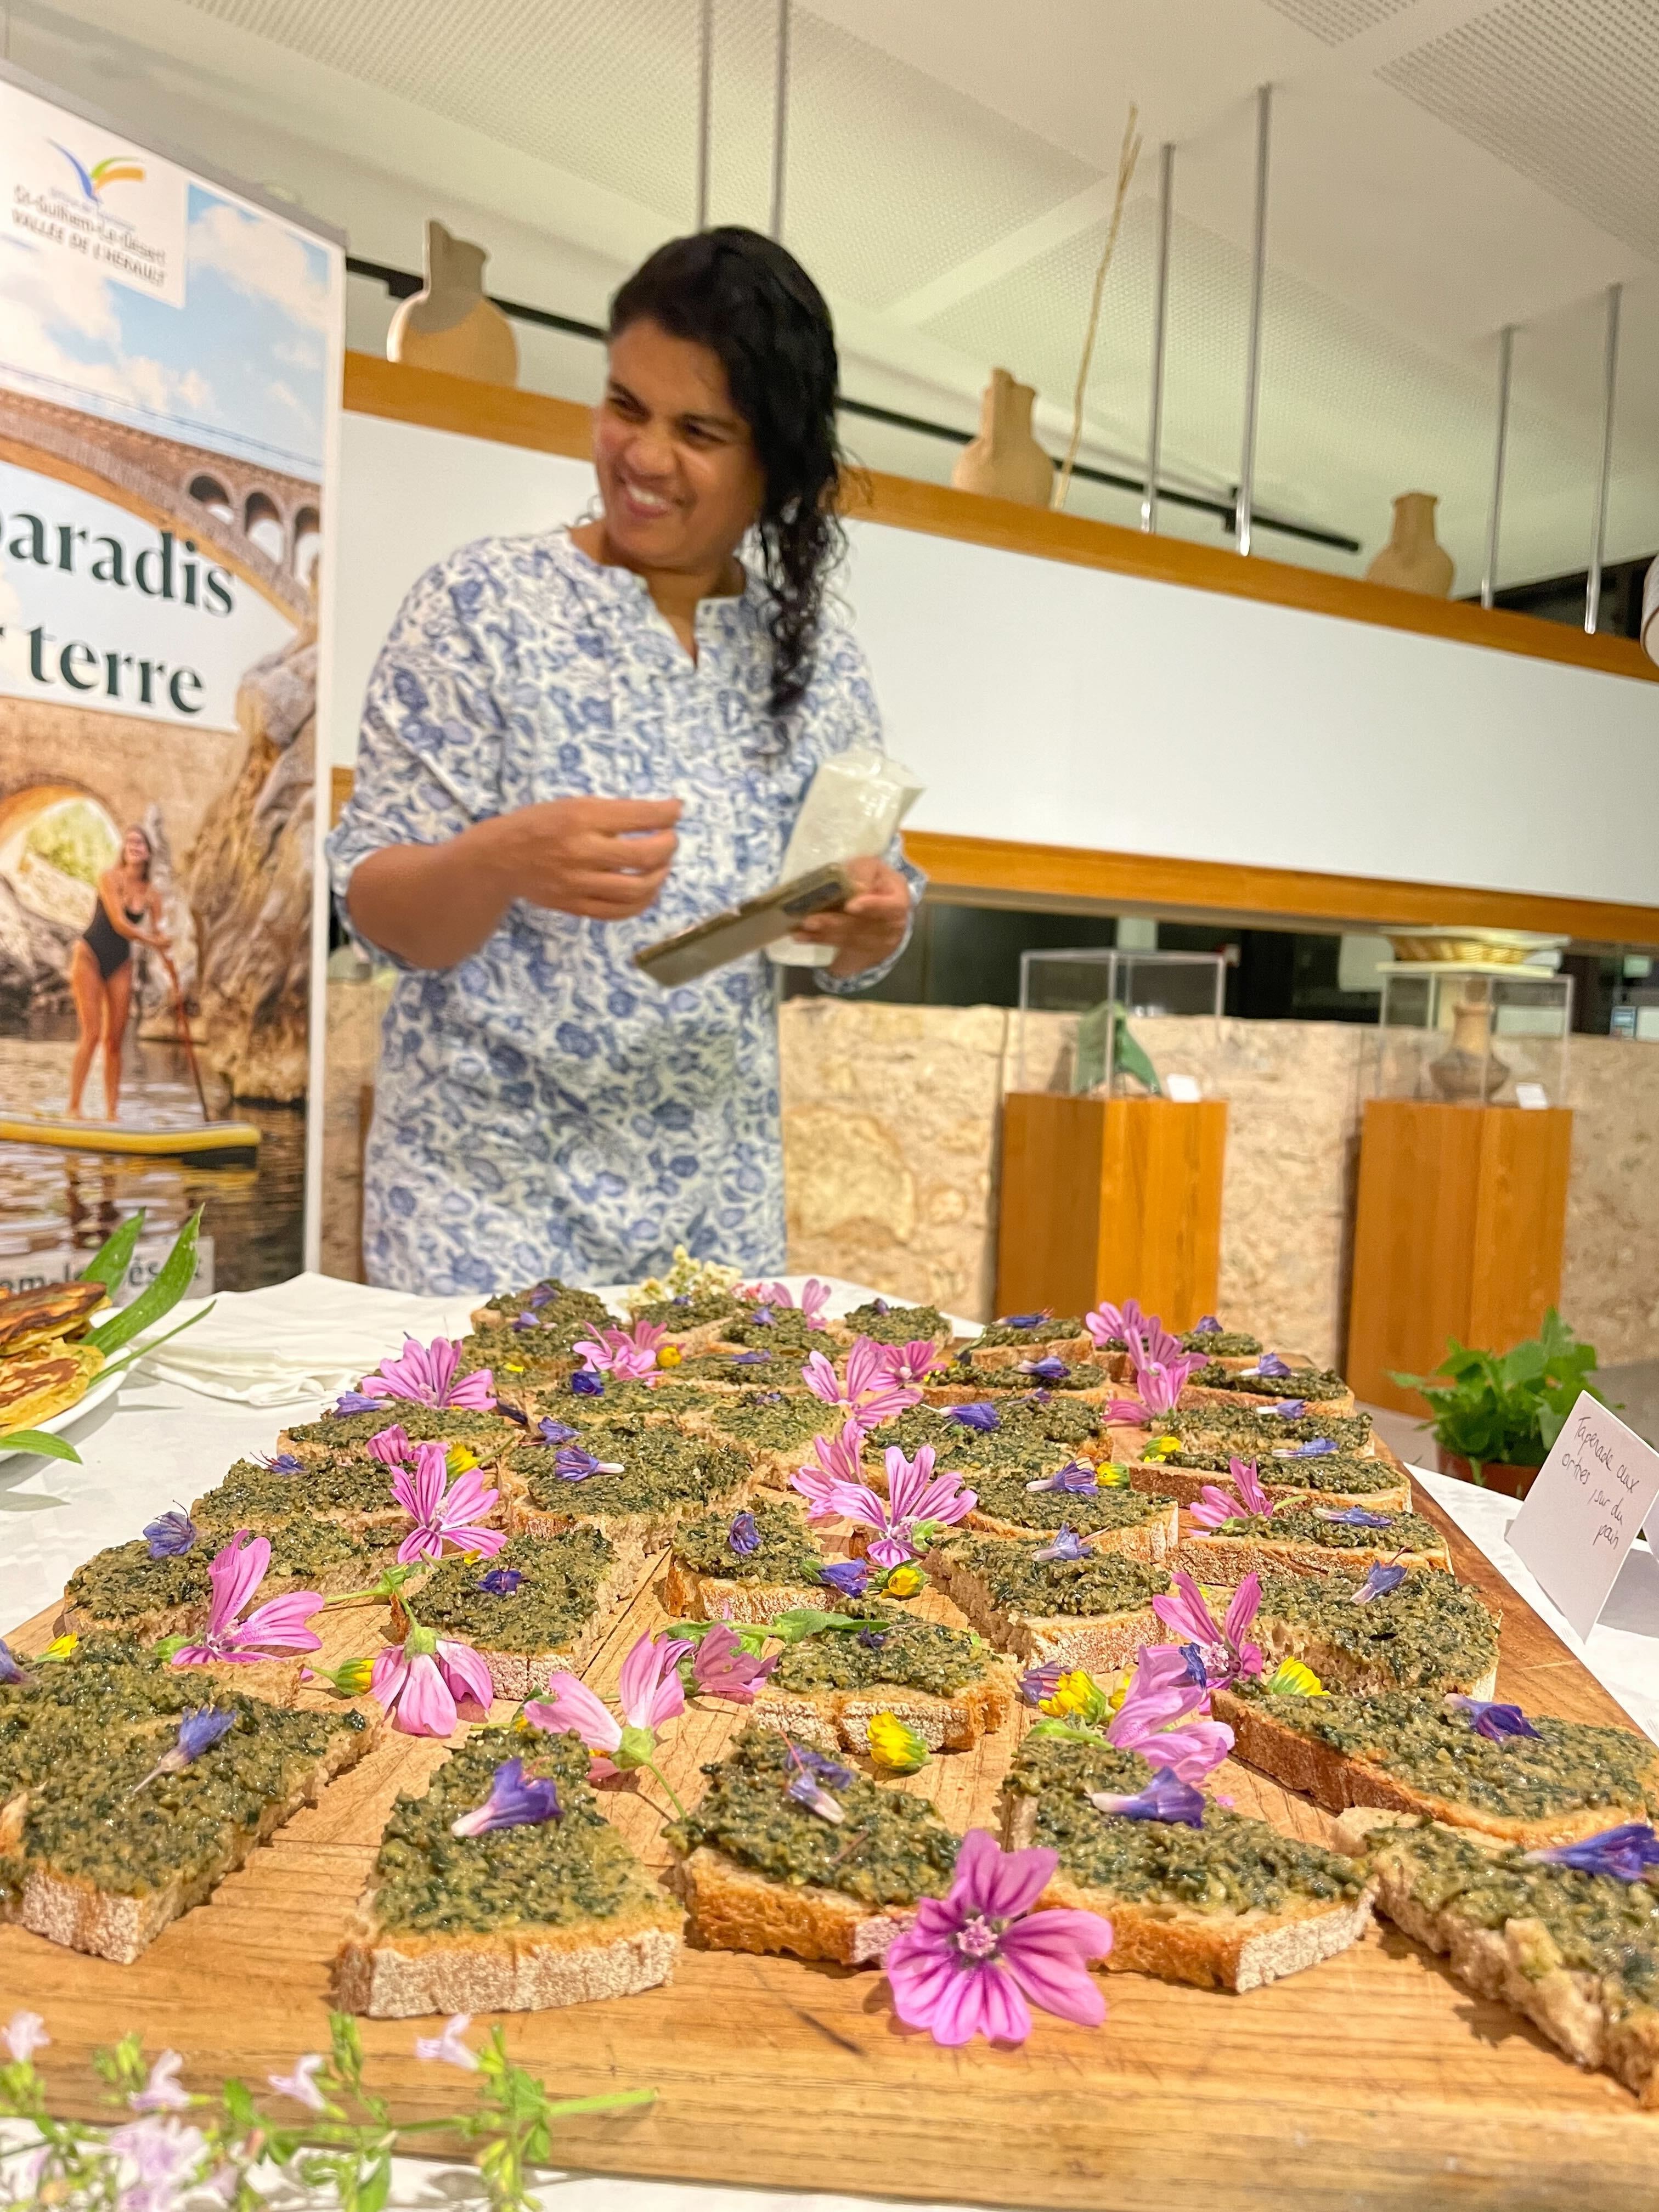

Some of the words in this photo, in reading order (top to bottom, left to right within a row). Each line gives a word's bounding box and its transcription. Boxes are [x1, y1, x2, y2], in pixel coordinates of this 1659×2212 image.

[69, 232, 89, 255] DE
[0, 513, 234, 615] aradis
[27, 625, 205, 713] terre
[1611, 1497, 1624, 1526] du
[1593, 1524, 1620, 1550] pain
